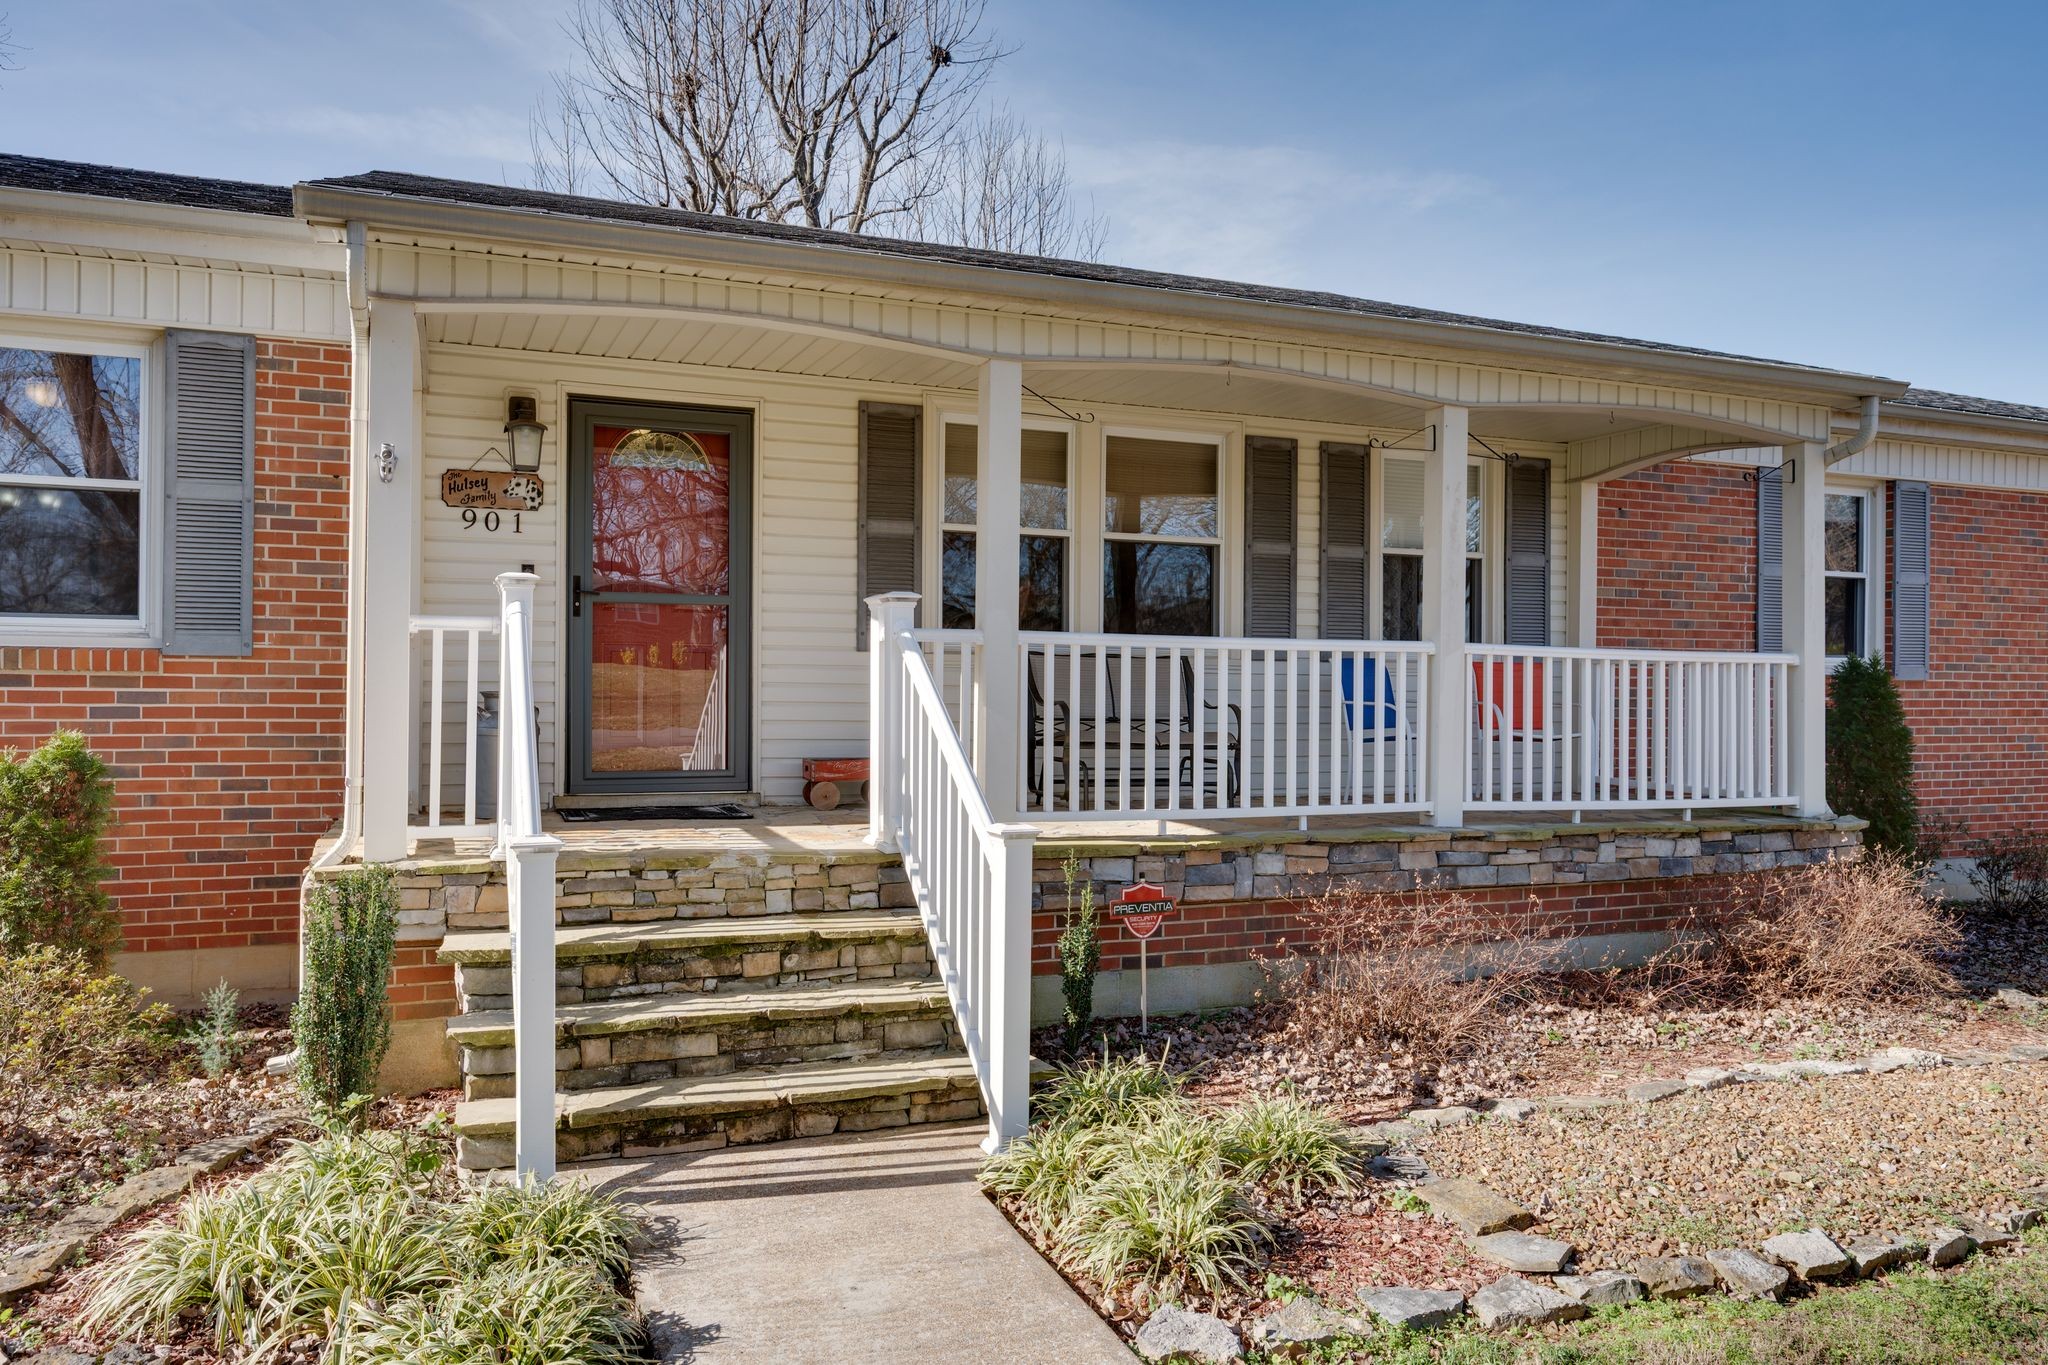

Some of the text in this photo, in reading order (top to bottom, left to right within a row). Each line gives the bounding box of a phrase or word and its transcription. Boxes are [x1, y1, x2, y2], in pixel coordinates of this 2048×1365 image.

[448, 477, 489, 496] Hulsey
[460, 490, 497, 506] Family
[461, 509, 523, 533] 901
[1113, 901, 1173, 915] PREVENTIA
